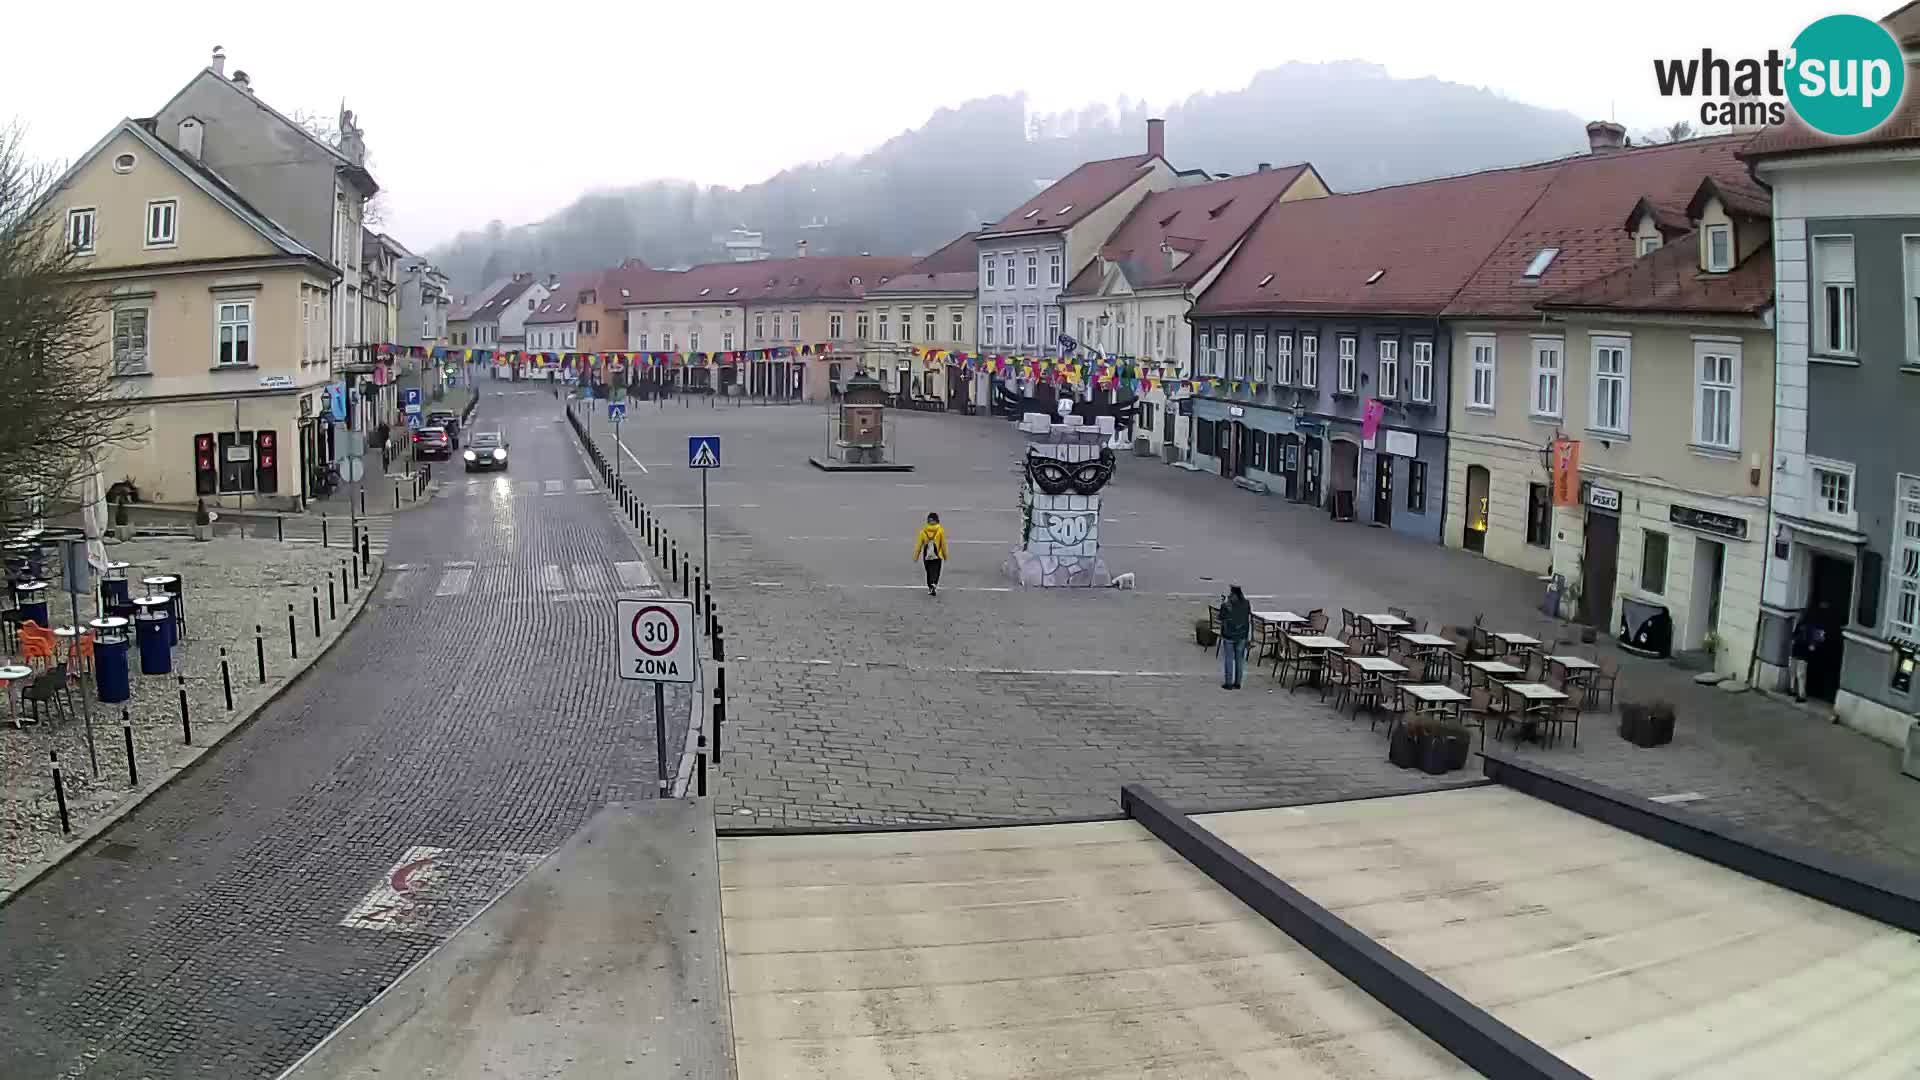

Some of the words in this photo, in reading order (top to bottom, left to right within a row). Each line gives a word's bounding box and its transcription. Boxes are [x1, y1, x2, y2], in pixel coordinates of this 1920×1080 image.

[408, 391, 417, 402] P
[644, 621, 668, 642] 30
[634, 658, 679, 675] ZONA
